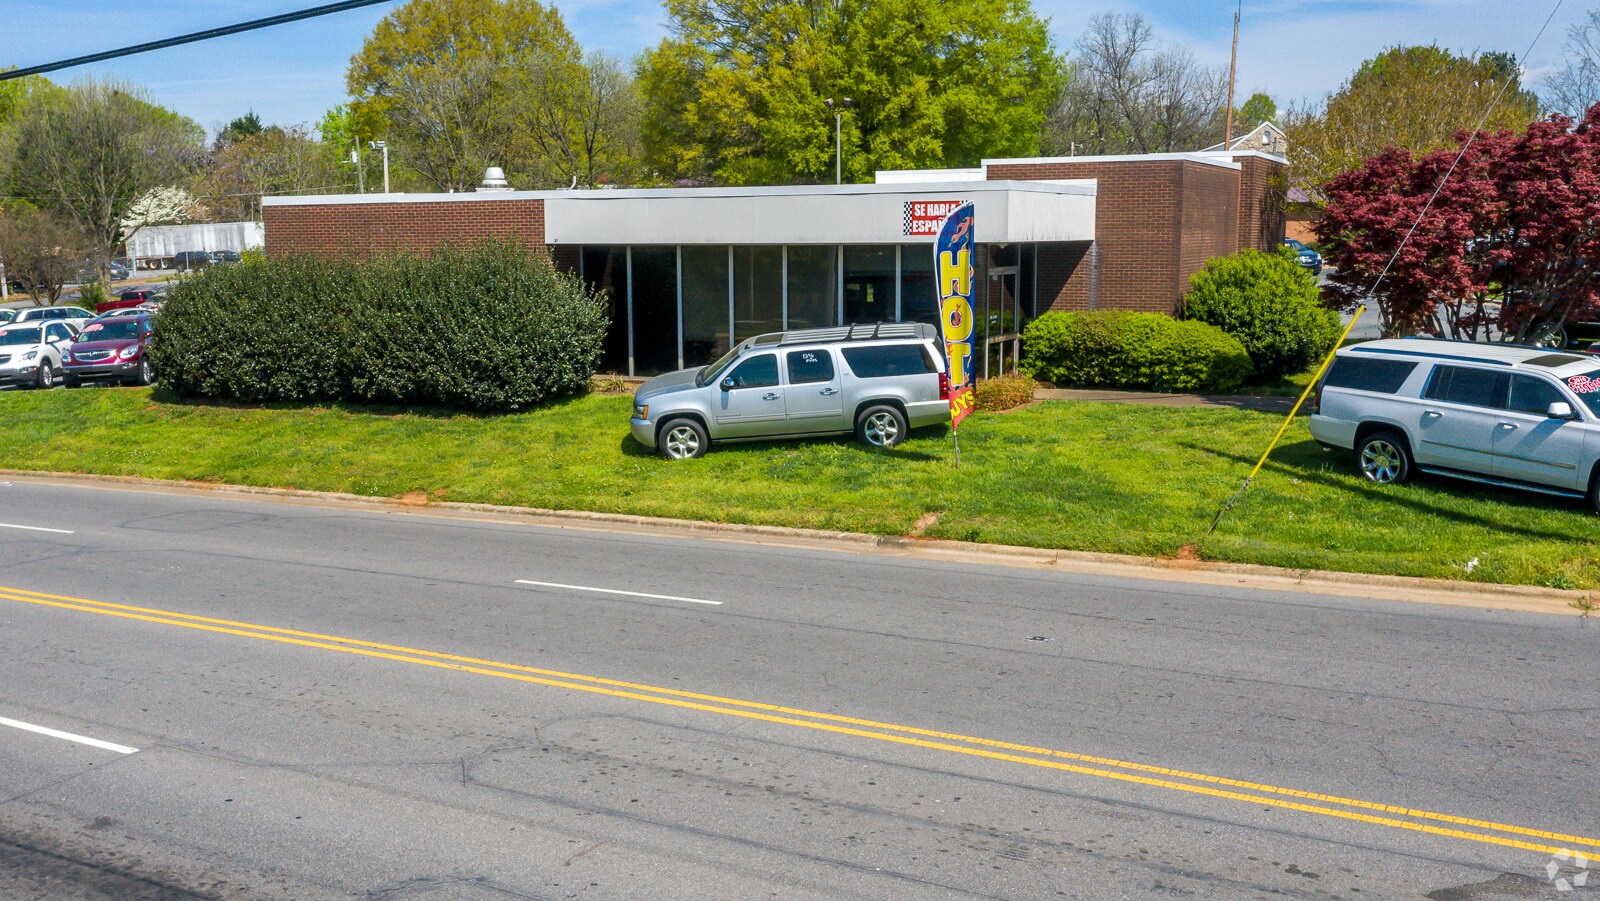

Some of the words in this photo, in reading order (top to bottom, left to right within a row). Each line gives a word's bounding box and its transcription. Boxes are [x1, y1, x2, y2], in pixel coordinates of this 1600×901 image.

[914, 203, 926, 216] SE
[940, 250, 973, 387] HOT
[951, 391, 976, 420] UYS
